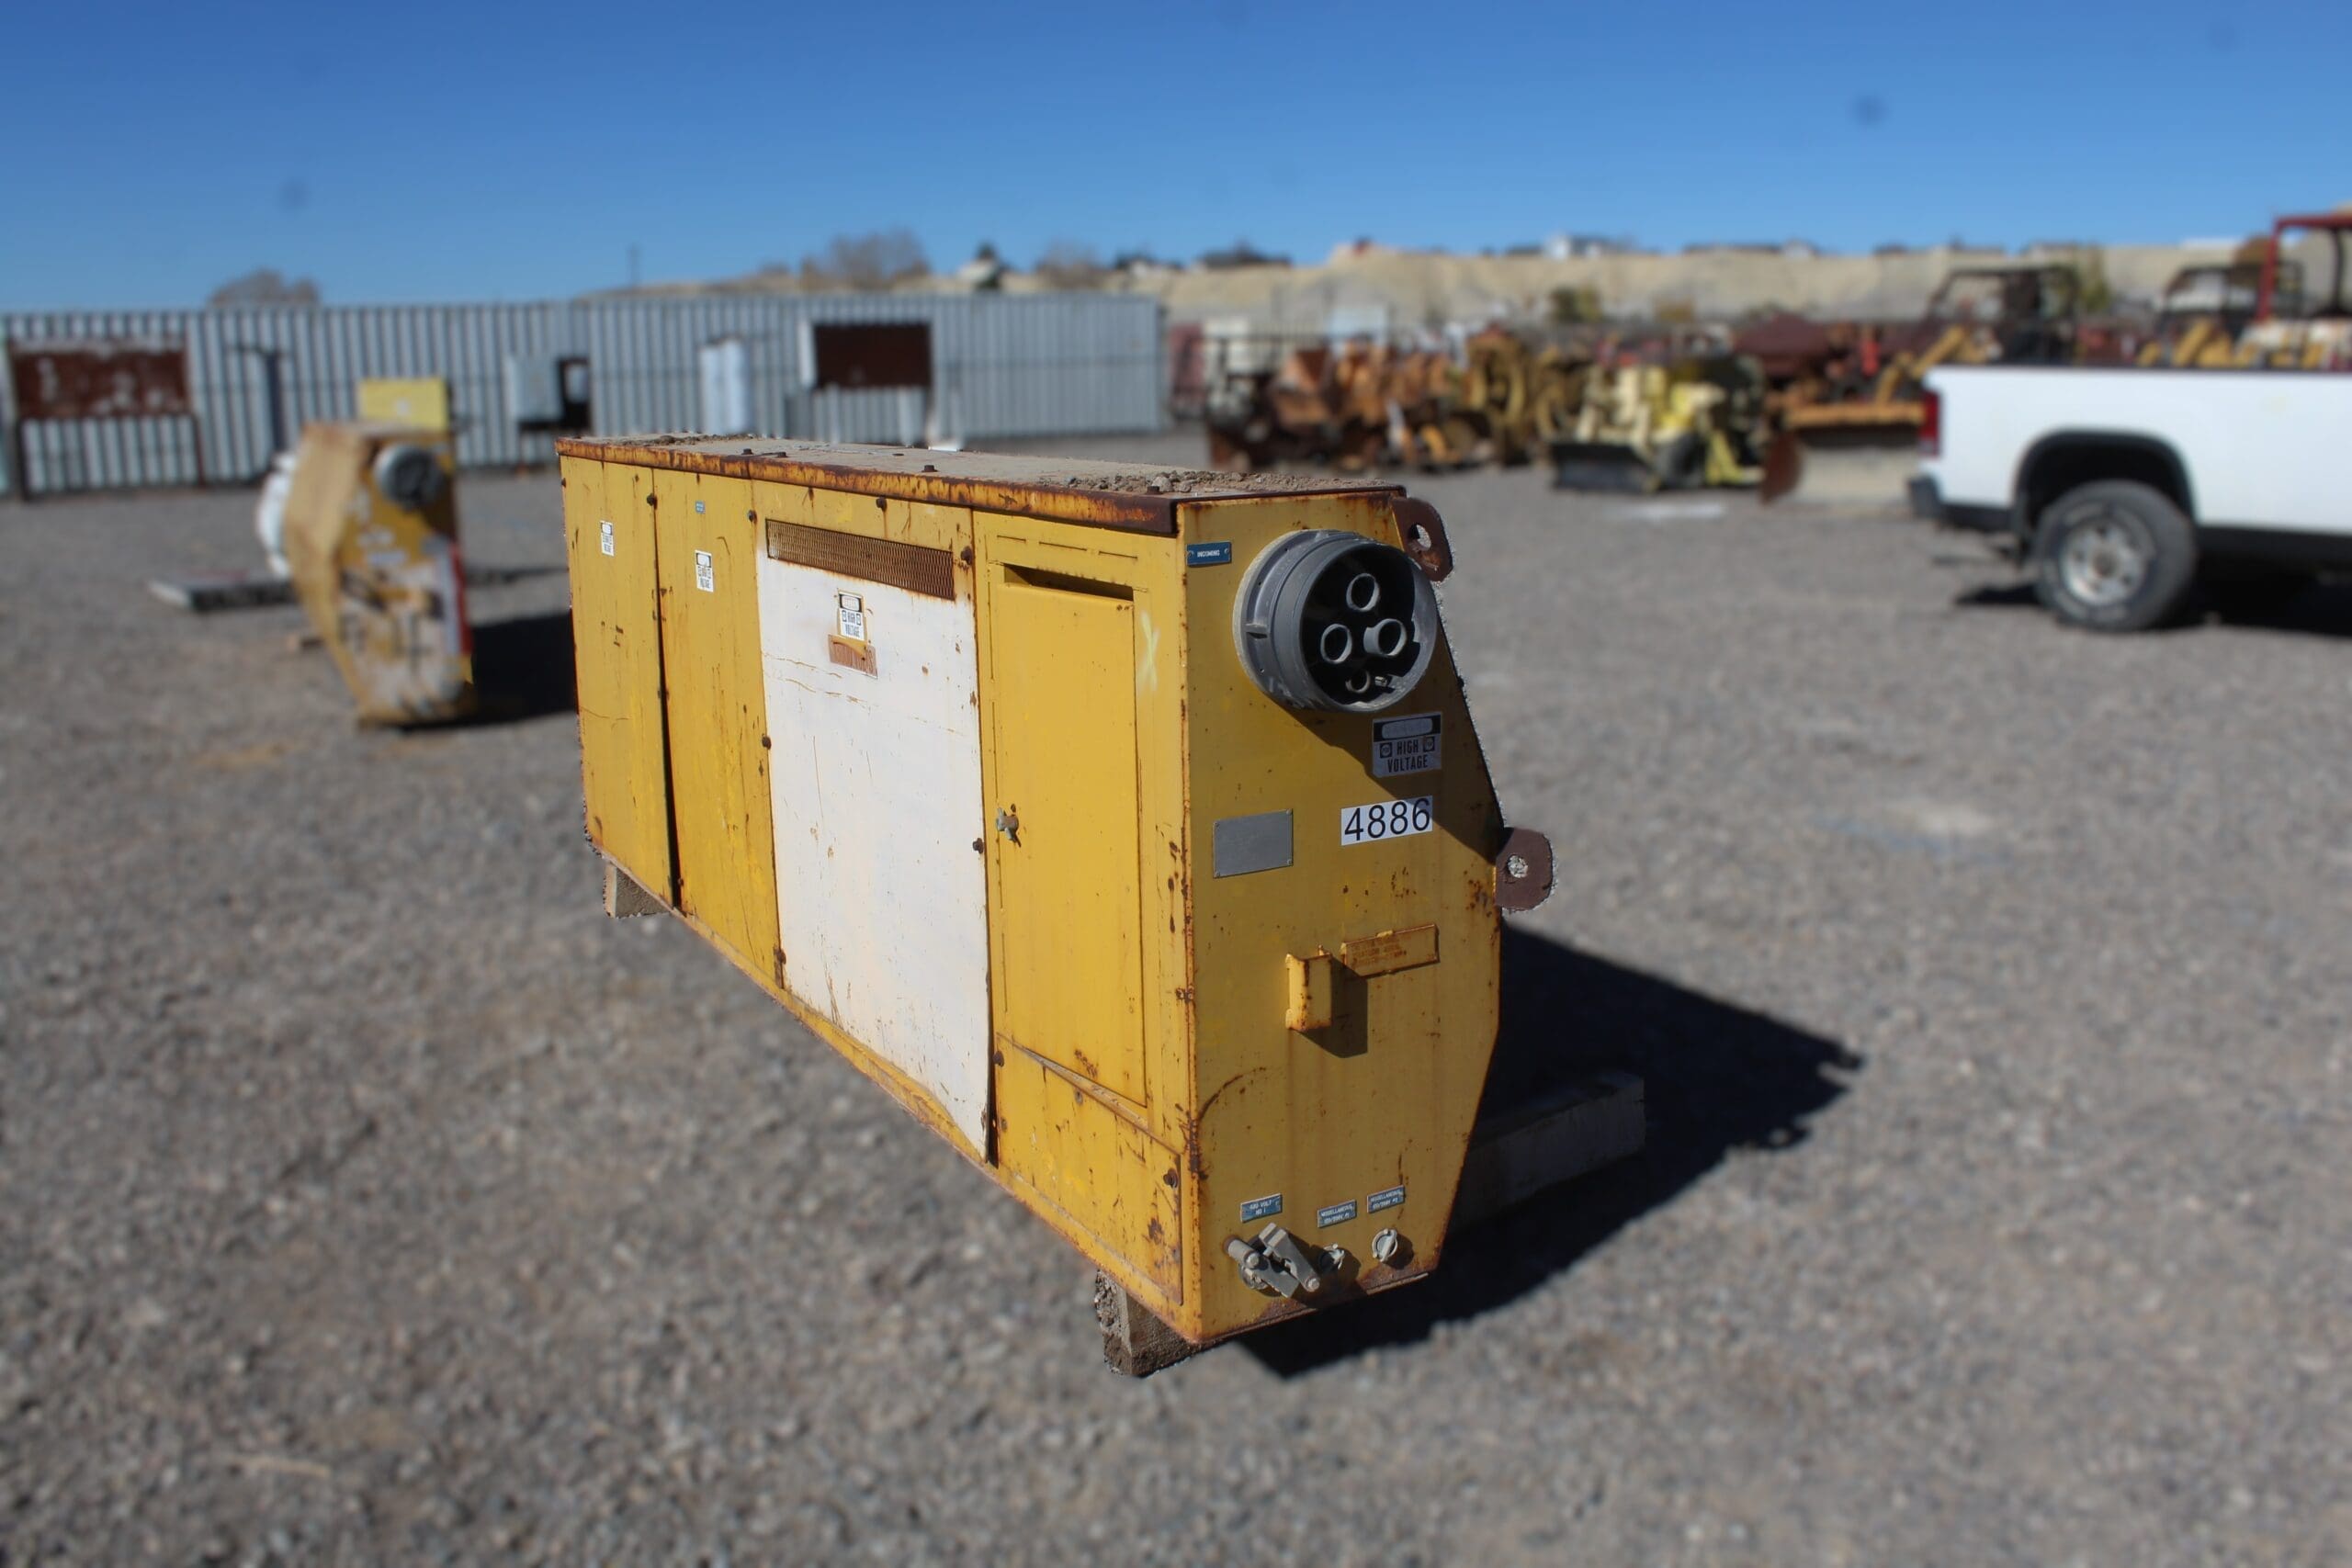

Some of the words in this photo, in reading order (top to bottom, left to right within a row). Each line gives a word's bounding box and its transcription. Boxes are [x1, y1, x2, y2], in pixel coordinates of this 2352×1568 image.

[1396, 739, 1419, 755] HIGH
[1387, 754, 1428, 773] VOLTAGE
[1344, 797, 1430, 841] 4886
